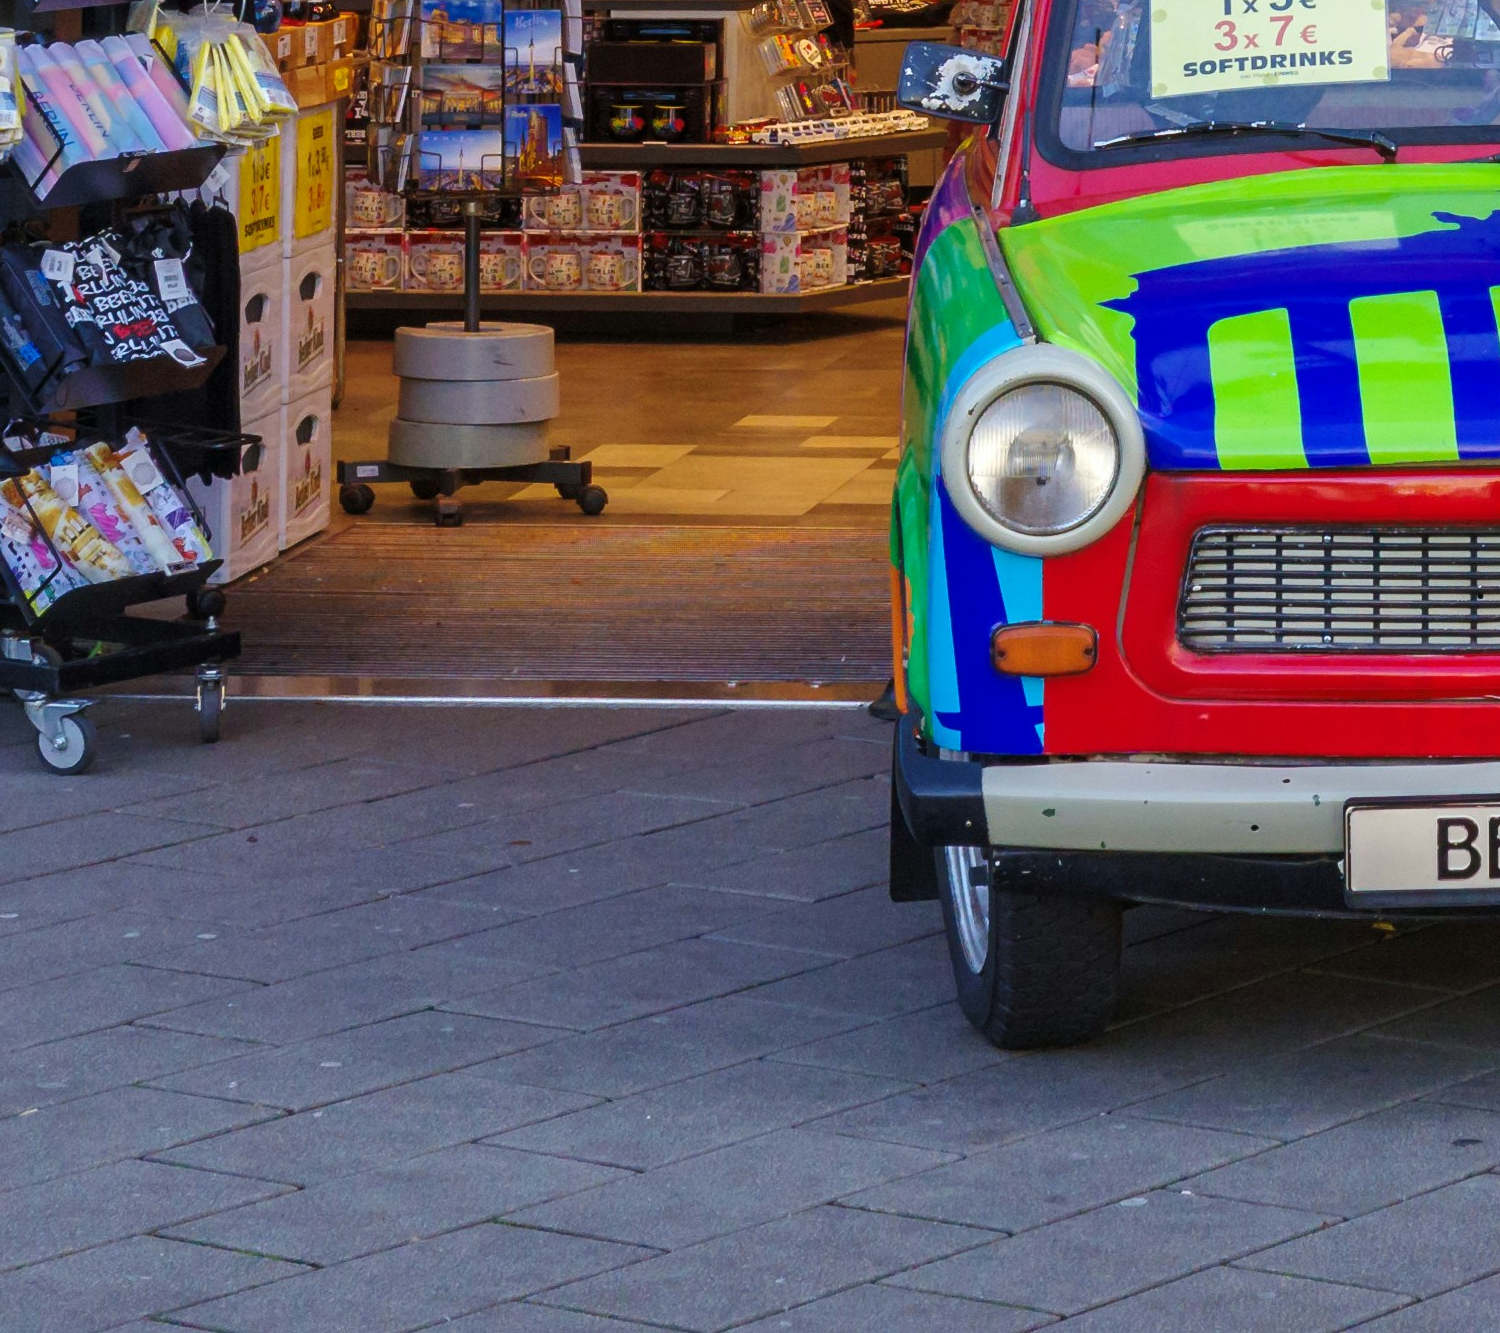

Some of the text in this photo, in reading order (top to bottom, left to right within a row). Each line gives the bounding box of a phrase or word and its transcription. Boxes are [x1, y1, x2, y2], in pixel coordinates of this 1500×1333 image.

[1242, 0, 1259, 13] x
[515, 13, 548, 28] Berlin
[1213, 21, 1238, 51] 3
[1243, 33, 1260, 49] x
[1183, 50, 1353, 77] SOFTDRINKS
